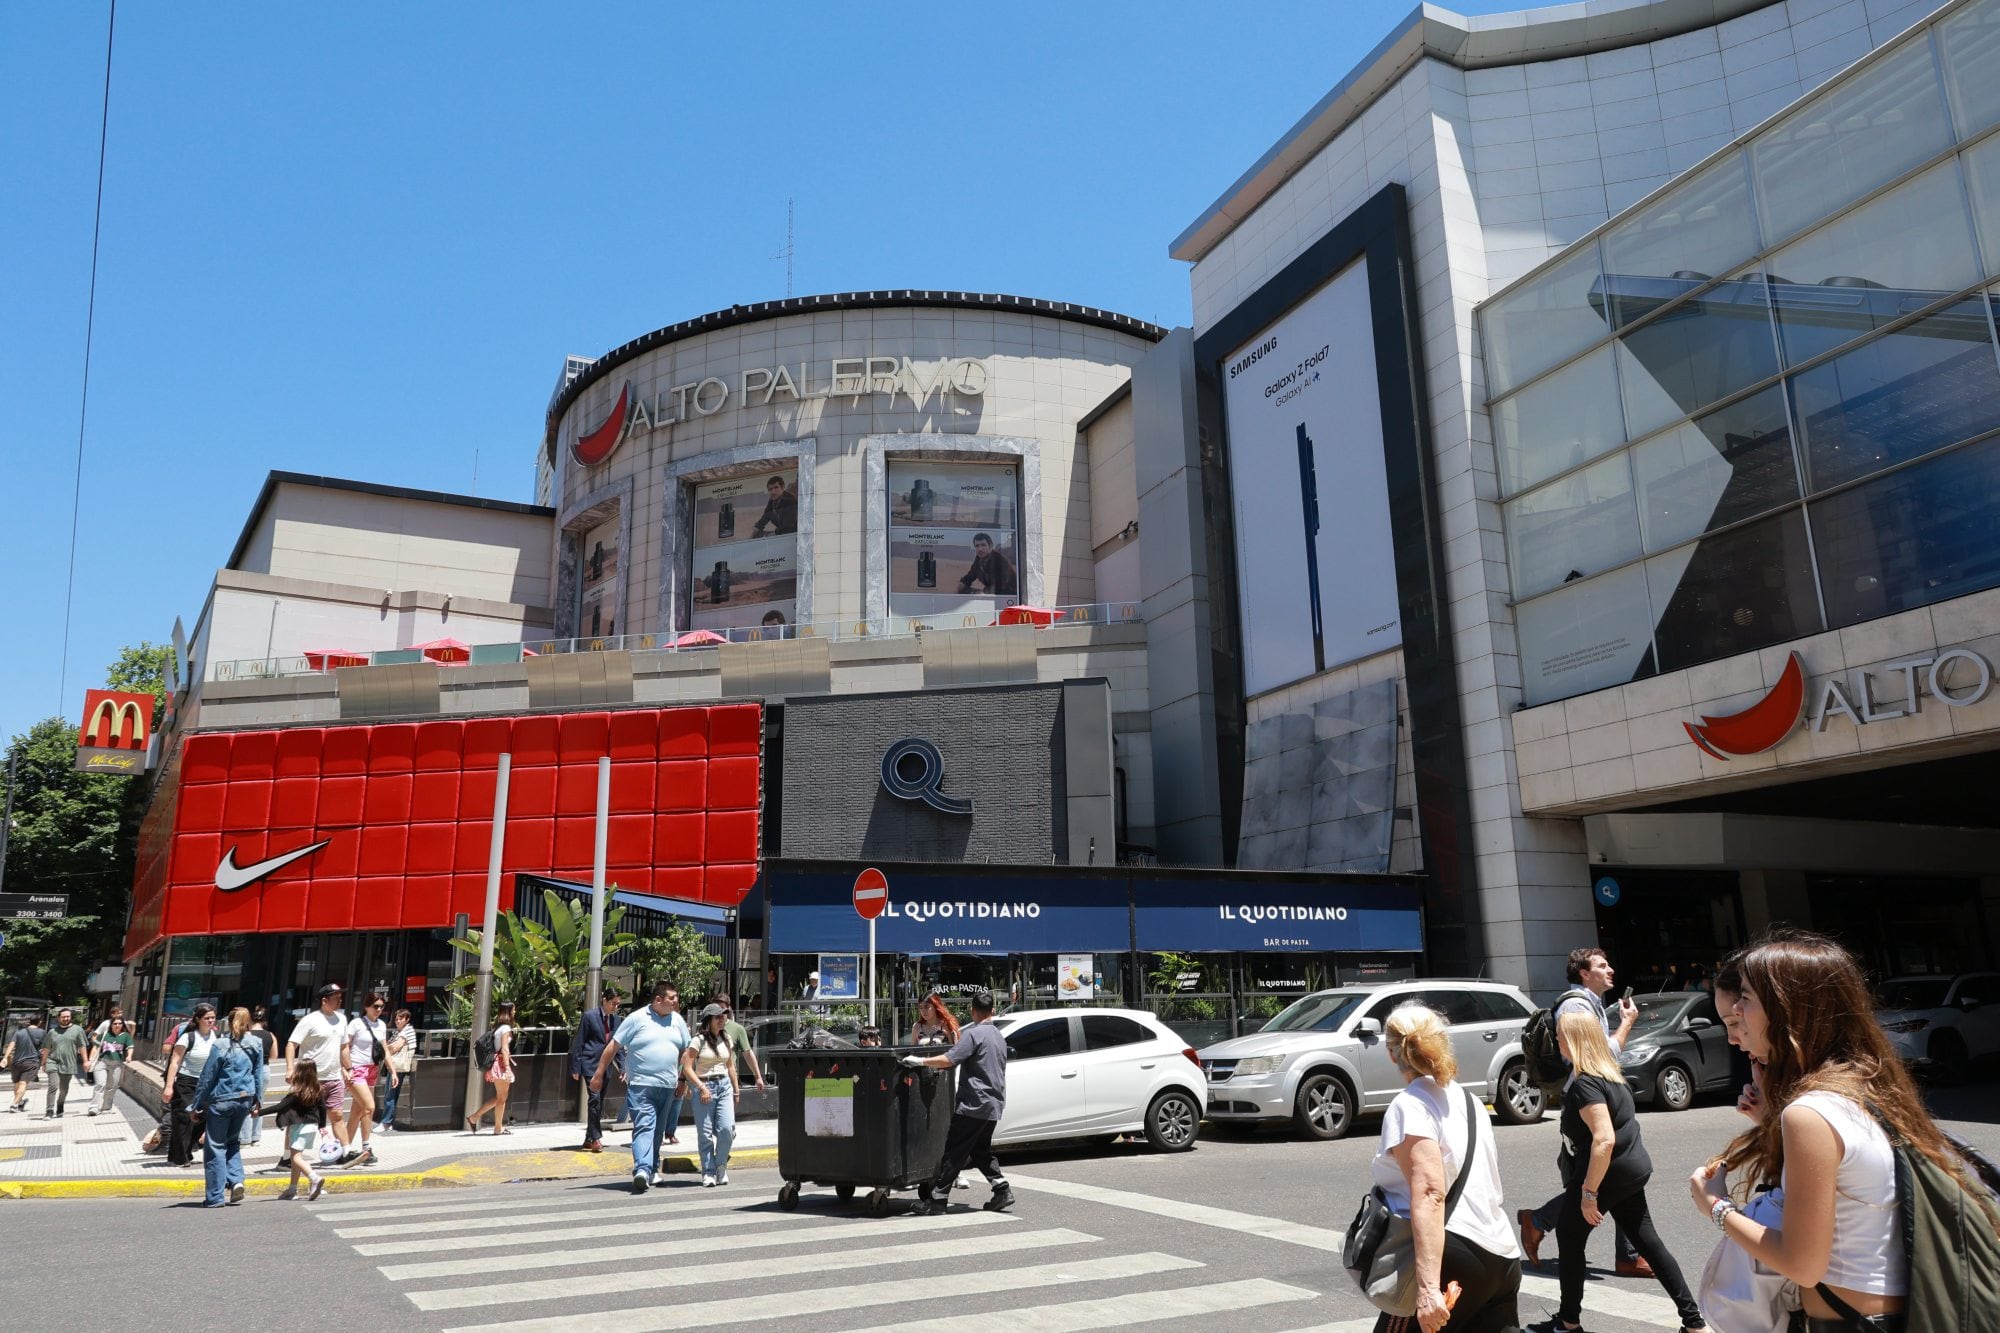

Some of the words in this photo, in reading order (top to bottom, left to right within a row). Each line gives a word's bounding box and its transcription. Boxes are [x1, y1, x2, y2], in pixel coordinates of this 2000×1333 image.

[1230, 337, 1277, 379] SAMSUNG
[1264, 370, 1298, 398] Galaxy
[1297, 363, 1305, 376] Z
[1304, 344, 1330, 371] Fold7
[1275, 384, 1303, 407] Galaxy
[1303, 376, 1312, 389] AI
[625, 376, 729, 439] ALTO
[742, 356, 991, 406] PALERMO
[712, 484, 743, 494] MONTBLANC
[755, 556, 786, 565] MONTBLANC
[1815, 649, 1995, 733] ALTO
[28, 895, 65, 903] Arenales
[16, 910, 36, 918] 3300
[904, 901, 1041, 922] QUOTIDIANO
[1220, 905, 1236, 919] IL
[1239, 905, 1347, 923] QUOTIDIANO
[934, 938, 955, 947] BAR
[1263, 938, 1280, 947] BAR
[958, 983, 989, 994] PASTAS
[1265, 980, 1306, 988] QUOTIDIANO
